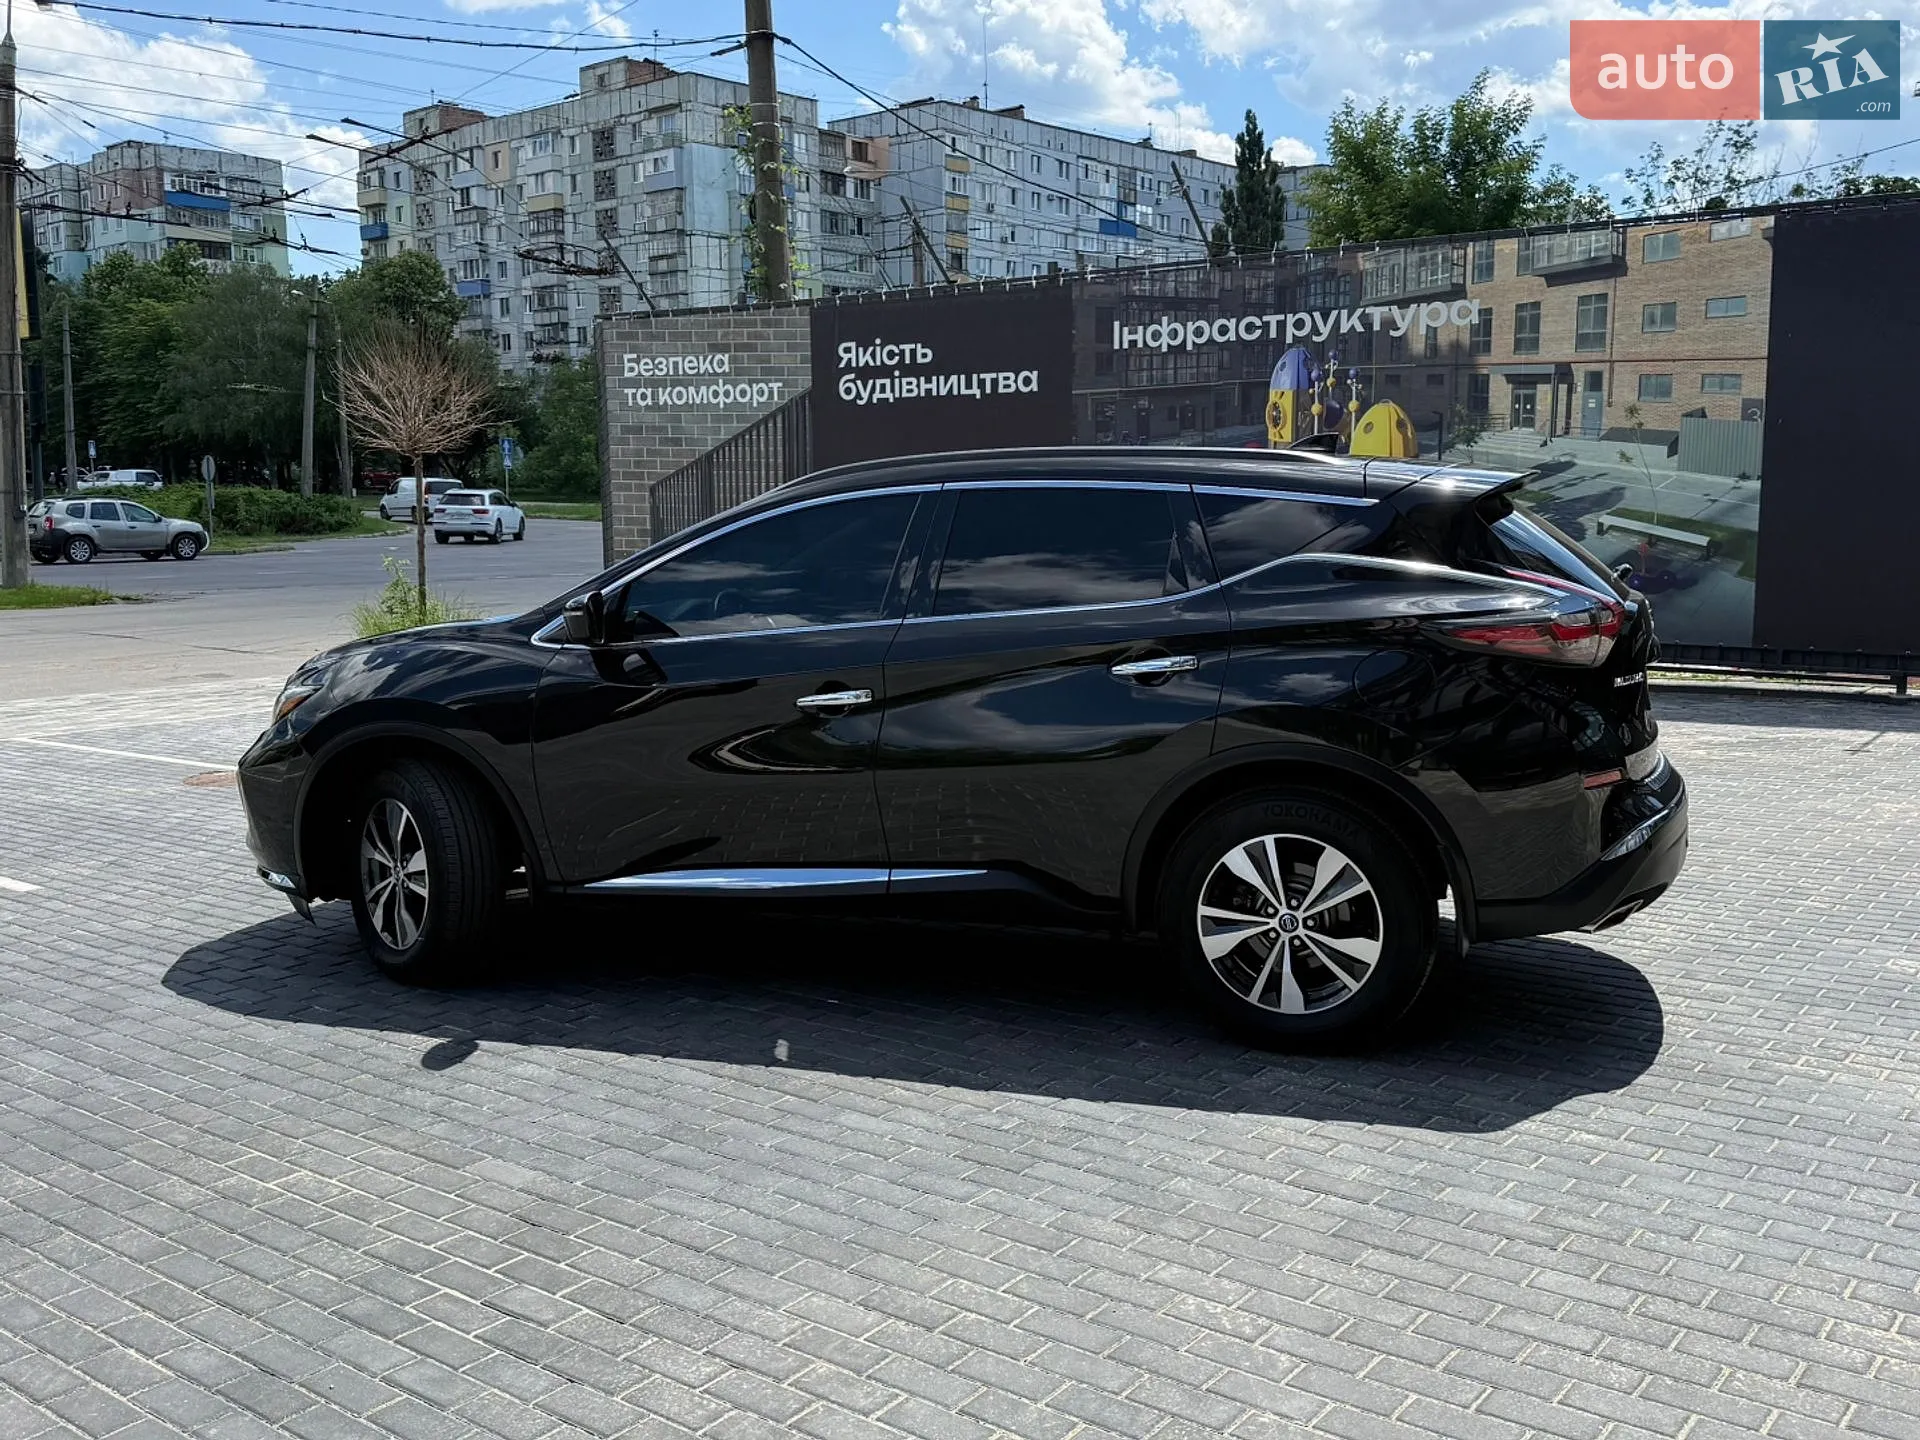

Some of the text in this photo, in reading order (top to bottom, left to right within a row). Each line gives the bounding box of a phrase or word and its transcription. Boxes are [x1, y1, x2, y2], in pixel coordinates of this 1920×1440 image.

[1113, 297, 1481, 351] Інфраструктура
[623, 351, 730, 378] Безпека
[838, 338, 934, 368] Якість
[624, 379, 783, 409] та комфорт
[839, 369, 1039, 404] будівництва
